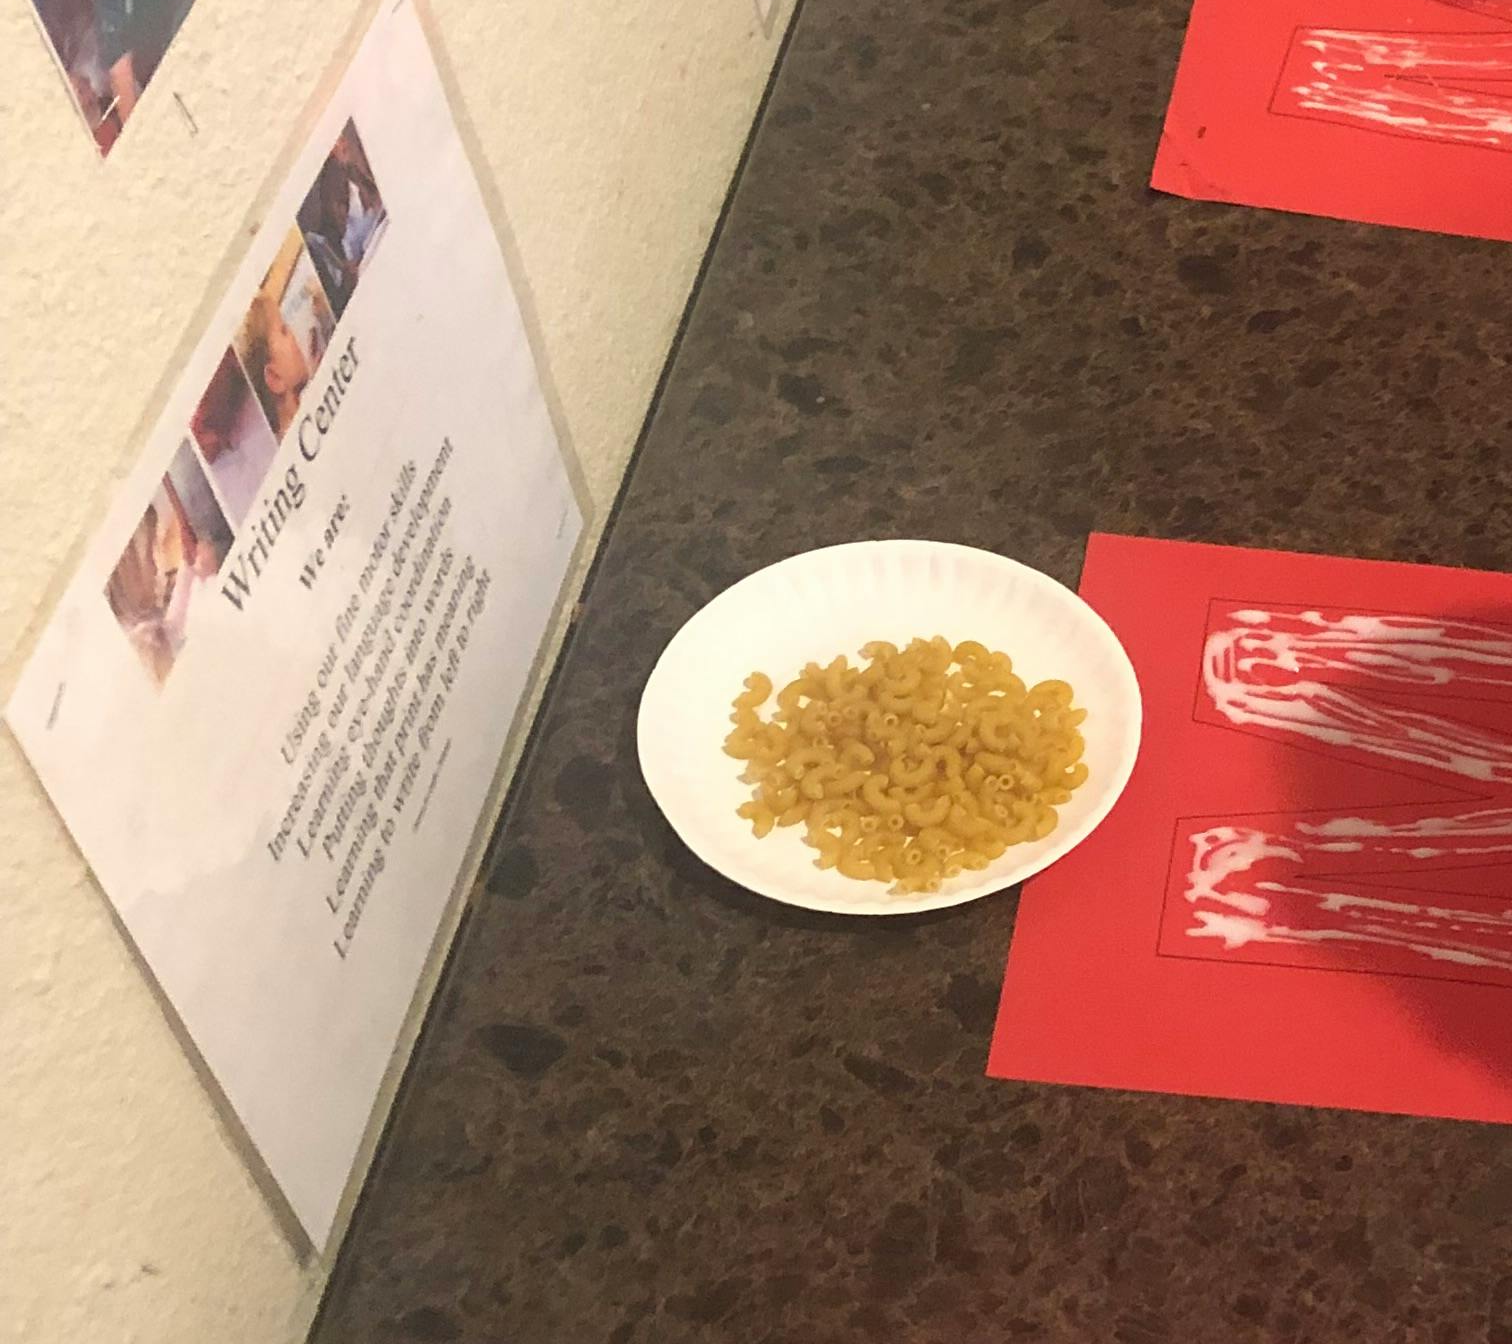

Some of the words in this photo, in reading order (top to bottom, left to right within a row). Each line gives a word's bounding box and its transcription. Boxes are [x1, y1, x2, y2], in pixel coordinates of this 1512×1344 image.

[222, 466, 304, 609] Writing
[299, 337, 357, 461] Center
[280, 690, 319, 764] Using
[317, 645, 337, 688] our
[335, 594, 359, 642] fine
[359, 522, 390, 592] motor
[390, 461, 415, 521] skills
[299, 548, 324, 589] We
[324, 494, 349, 548] are:
[267, 732, 329, 861] Increasing
[328, 683, 347, 728] our
[344, 578, 393, 682] language
[392, 437, 452, 576] development
[296, 746, 349, 858] Learning
[348, 629, 394, 742] eye-hand
[394, 497, 451, 632] coordination
[322, 771, 366, 859] Putting
[362, 671, 406, 767] thoughts
[405, 618, 425, 664] into
[424, 547, 453, 613] words
[326, 803, 377, 913] Learning
[373, 751, 396, 800] that
[394, 692, 421, 756] print
[416, 655, 436, 692] has
[435, 555, 474, 649] meaning
[333, 848, 384, 959] Learning
[380, 818, 394, 845] to
[393, 752, 420, 812] write
[418, 693, 444, 749] from
[440, 648, 459, 691] left
[456, 625, 468, 650] to
[467, 569, 490, 623] right
